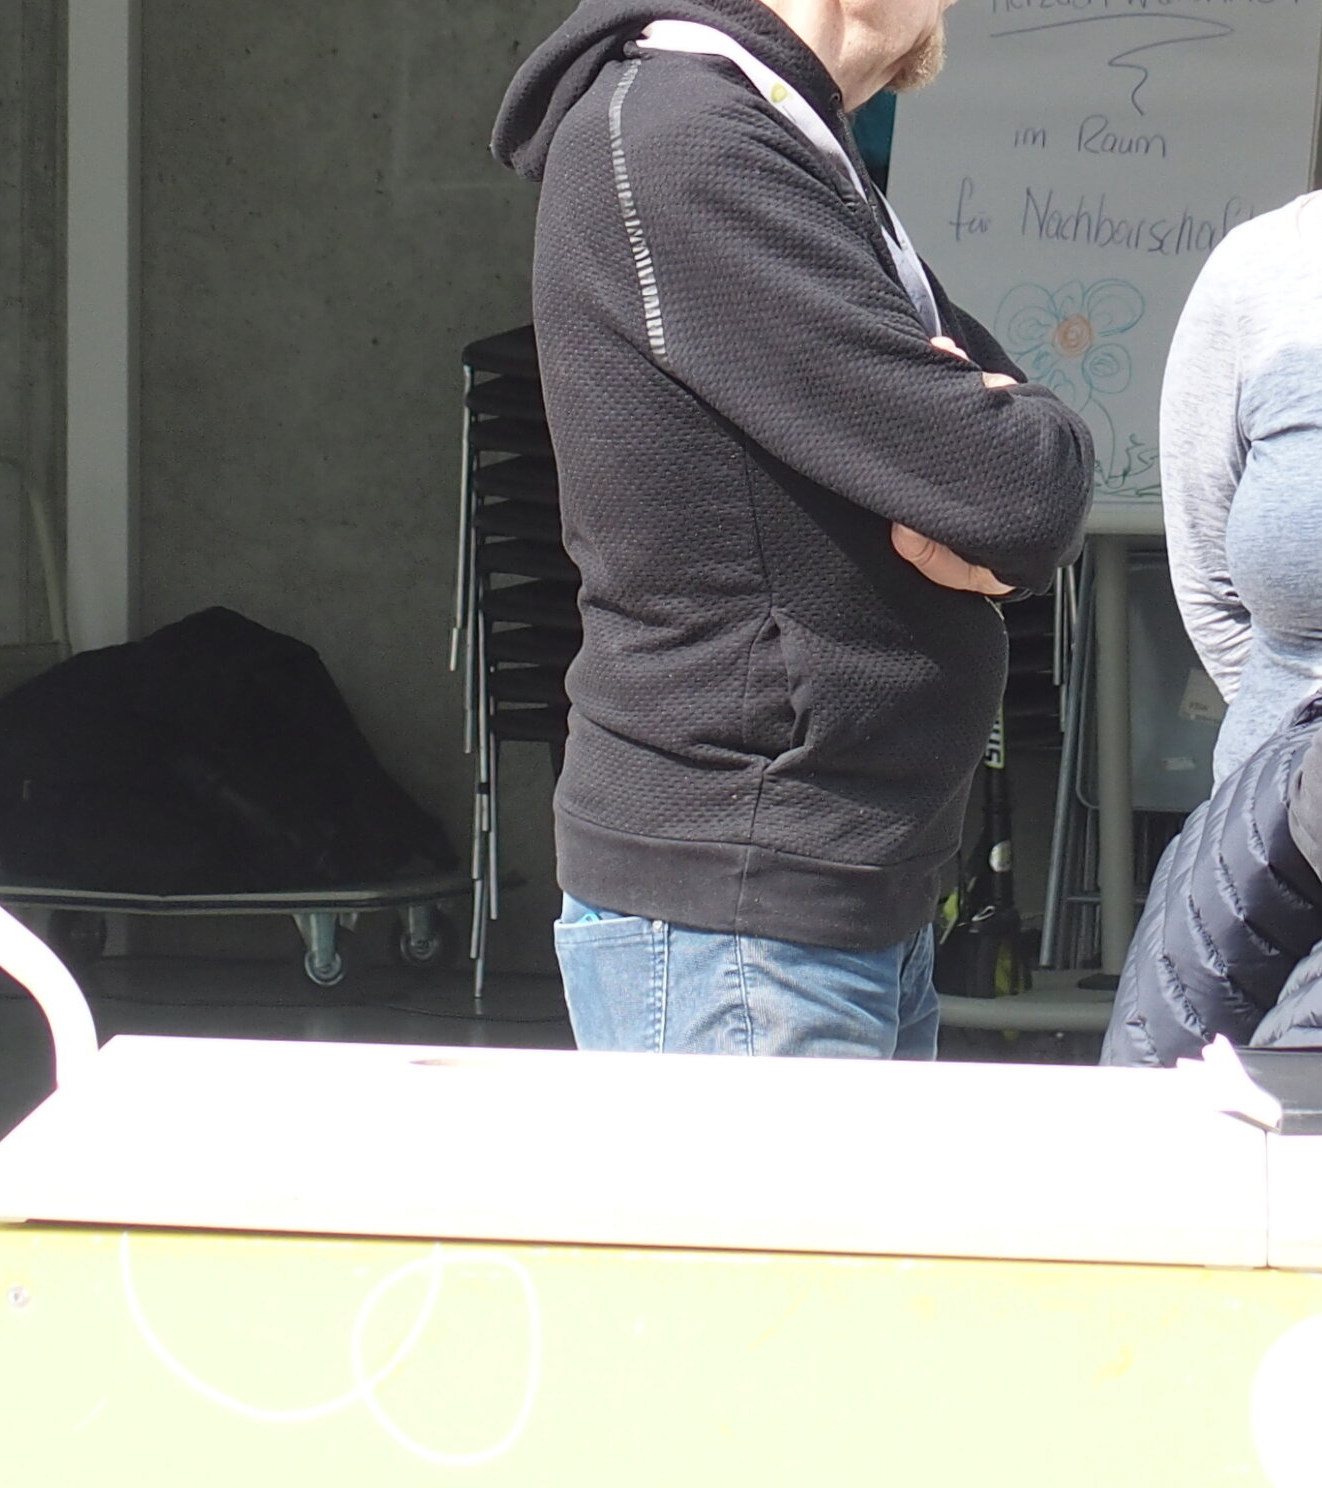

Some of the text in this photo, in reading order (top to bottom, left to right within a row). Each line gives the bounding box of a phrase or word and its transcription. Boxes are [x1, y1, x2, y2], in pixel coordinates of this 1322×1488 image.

[1013, 113, 1167, 159] im Raum
[1021, 186, 1255, 256] Nachbarschaf
